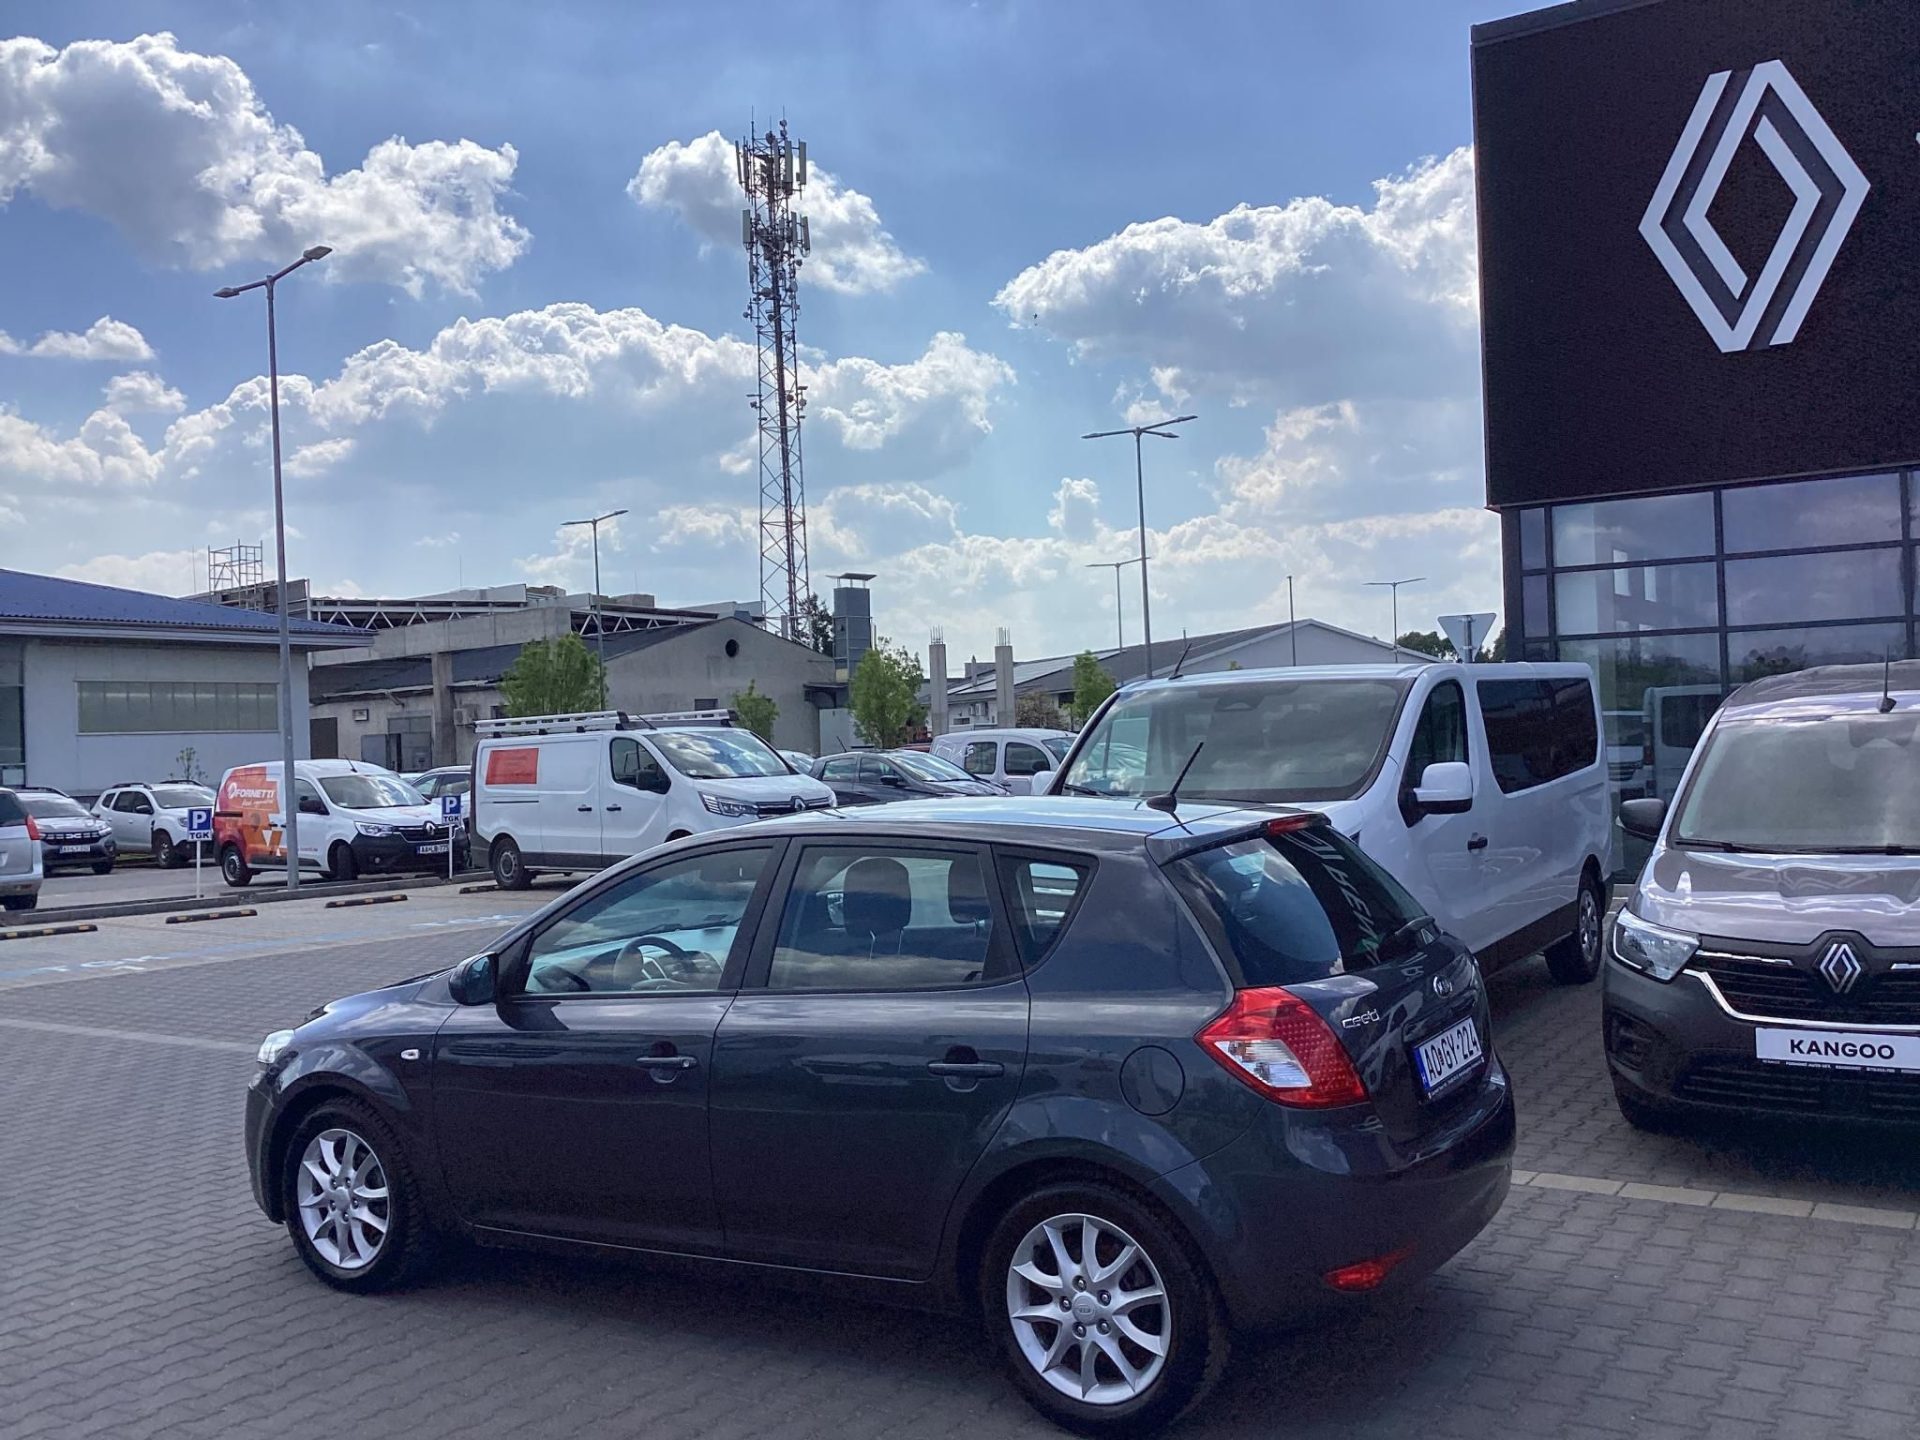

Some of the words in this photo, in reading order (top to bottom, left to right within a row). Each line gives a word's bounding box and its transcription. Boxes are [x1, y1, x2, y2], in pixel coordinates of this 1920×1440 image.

[446, 796, 457, 813] P
[192, 811, 207, 829] P
[1789, 1038, 1895, 1060] KANGOO
